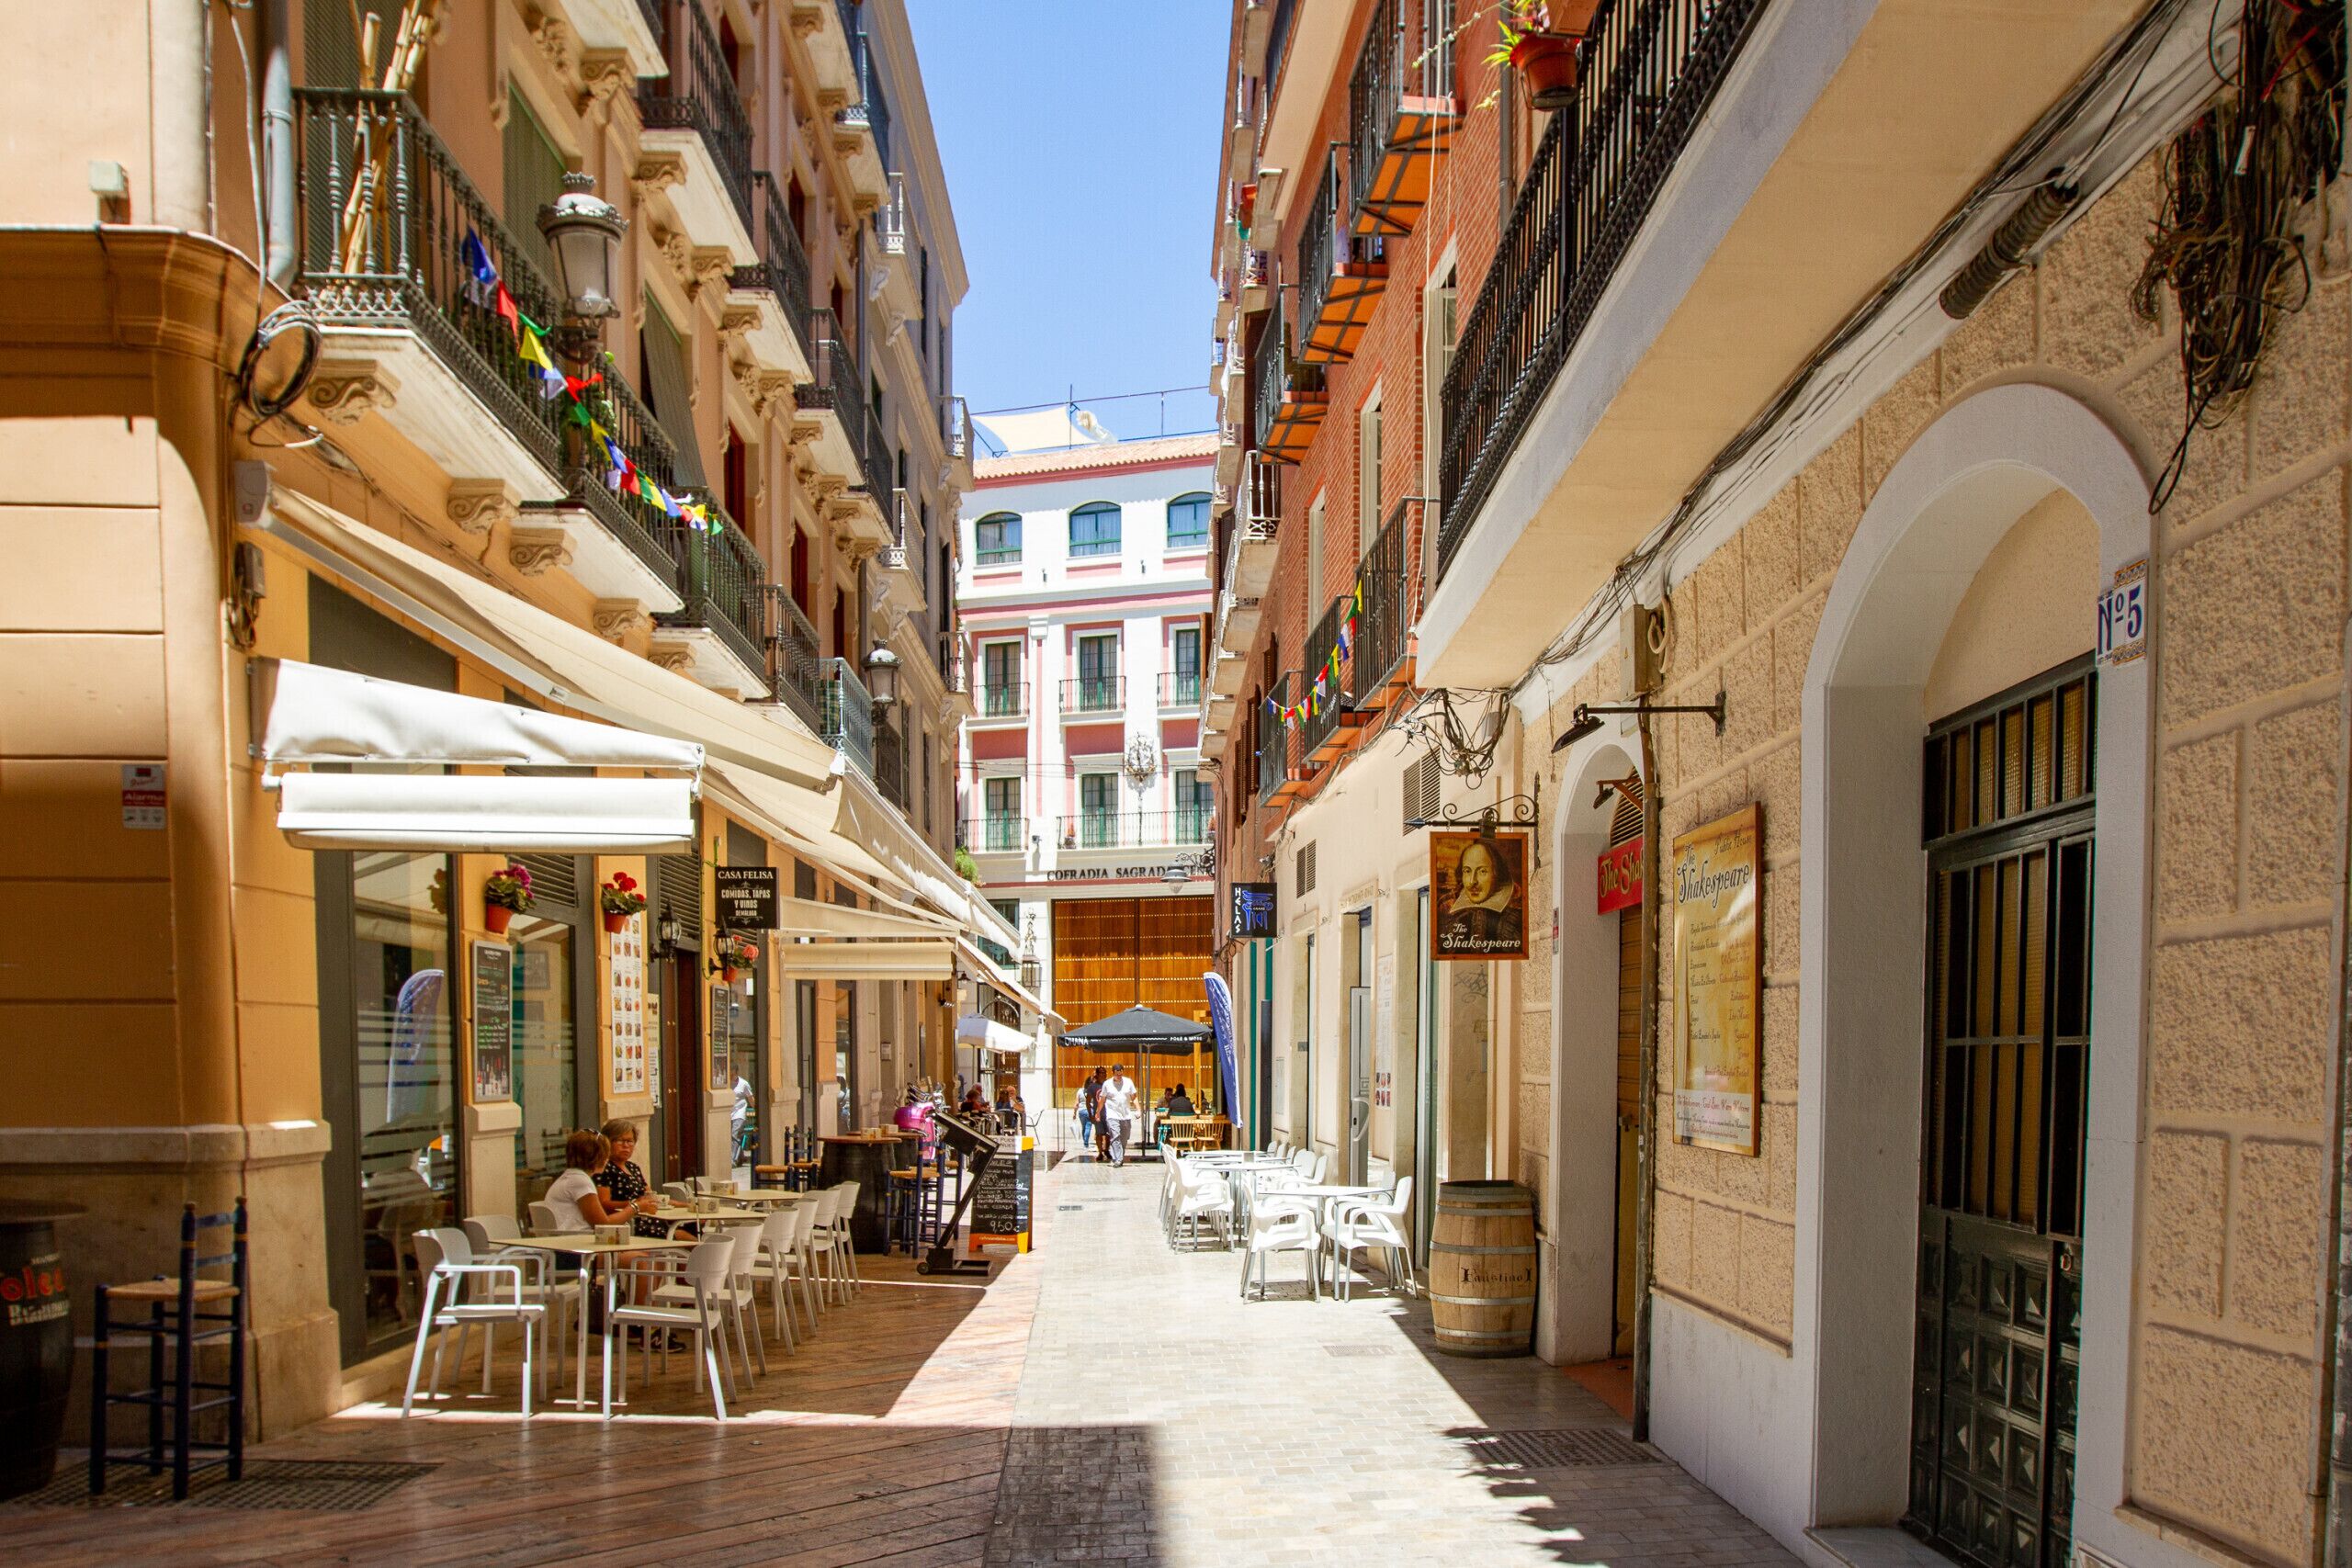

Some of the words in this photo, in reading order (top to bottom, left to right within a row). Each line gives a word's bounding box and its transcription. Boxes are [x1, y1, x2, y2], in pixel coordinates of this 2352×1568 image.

[718, 871, 741, 879] CASA
[743, 871, 774, 879] FELISA
[1047, 869, 1109, 881] COFRADIA
[1677, 861, 1749, 908] Shakespeare
[721, 889, 751, 898] COMIDAS,
[752, 889, 771, 898] TAPAS
[734, 900, 739, 908] Y
[740, 900, 758, 908] VINOS
[1453, 923, 1467, 932] The
[1441, 933, 1521, 953] Shakespeare
[1461, 1268, 1523, 1282] Faustino
